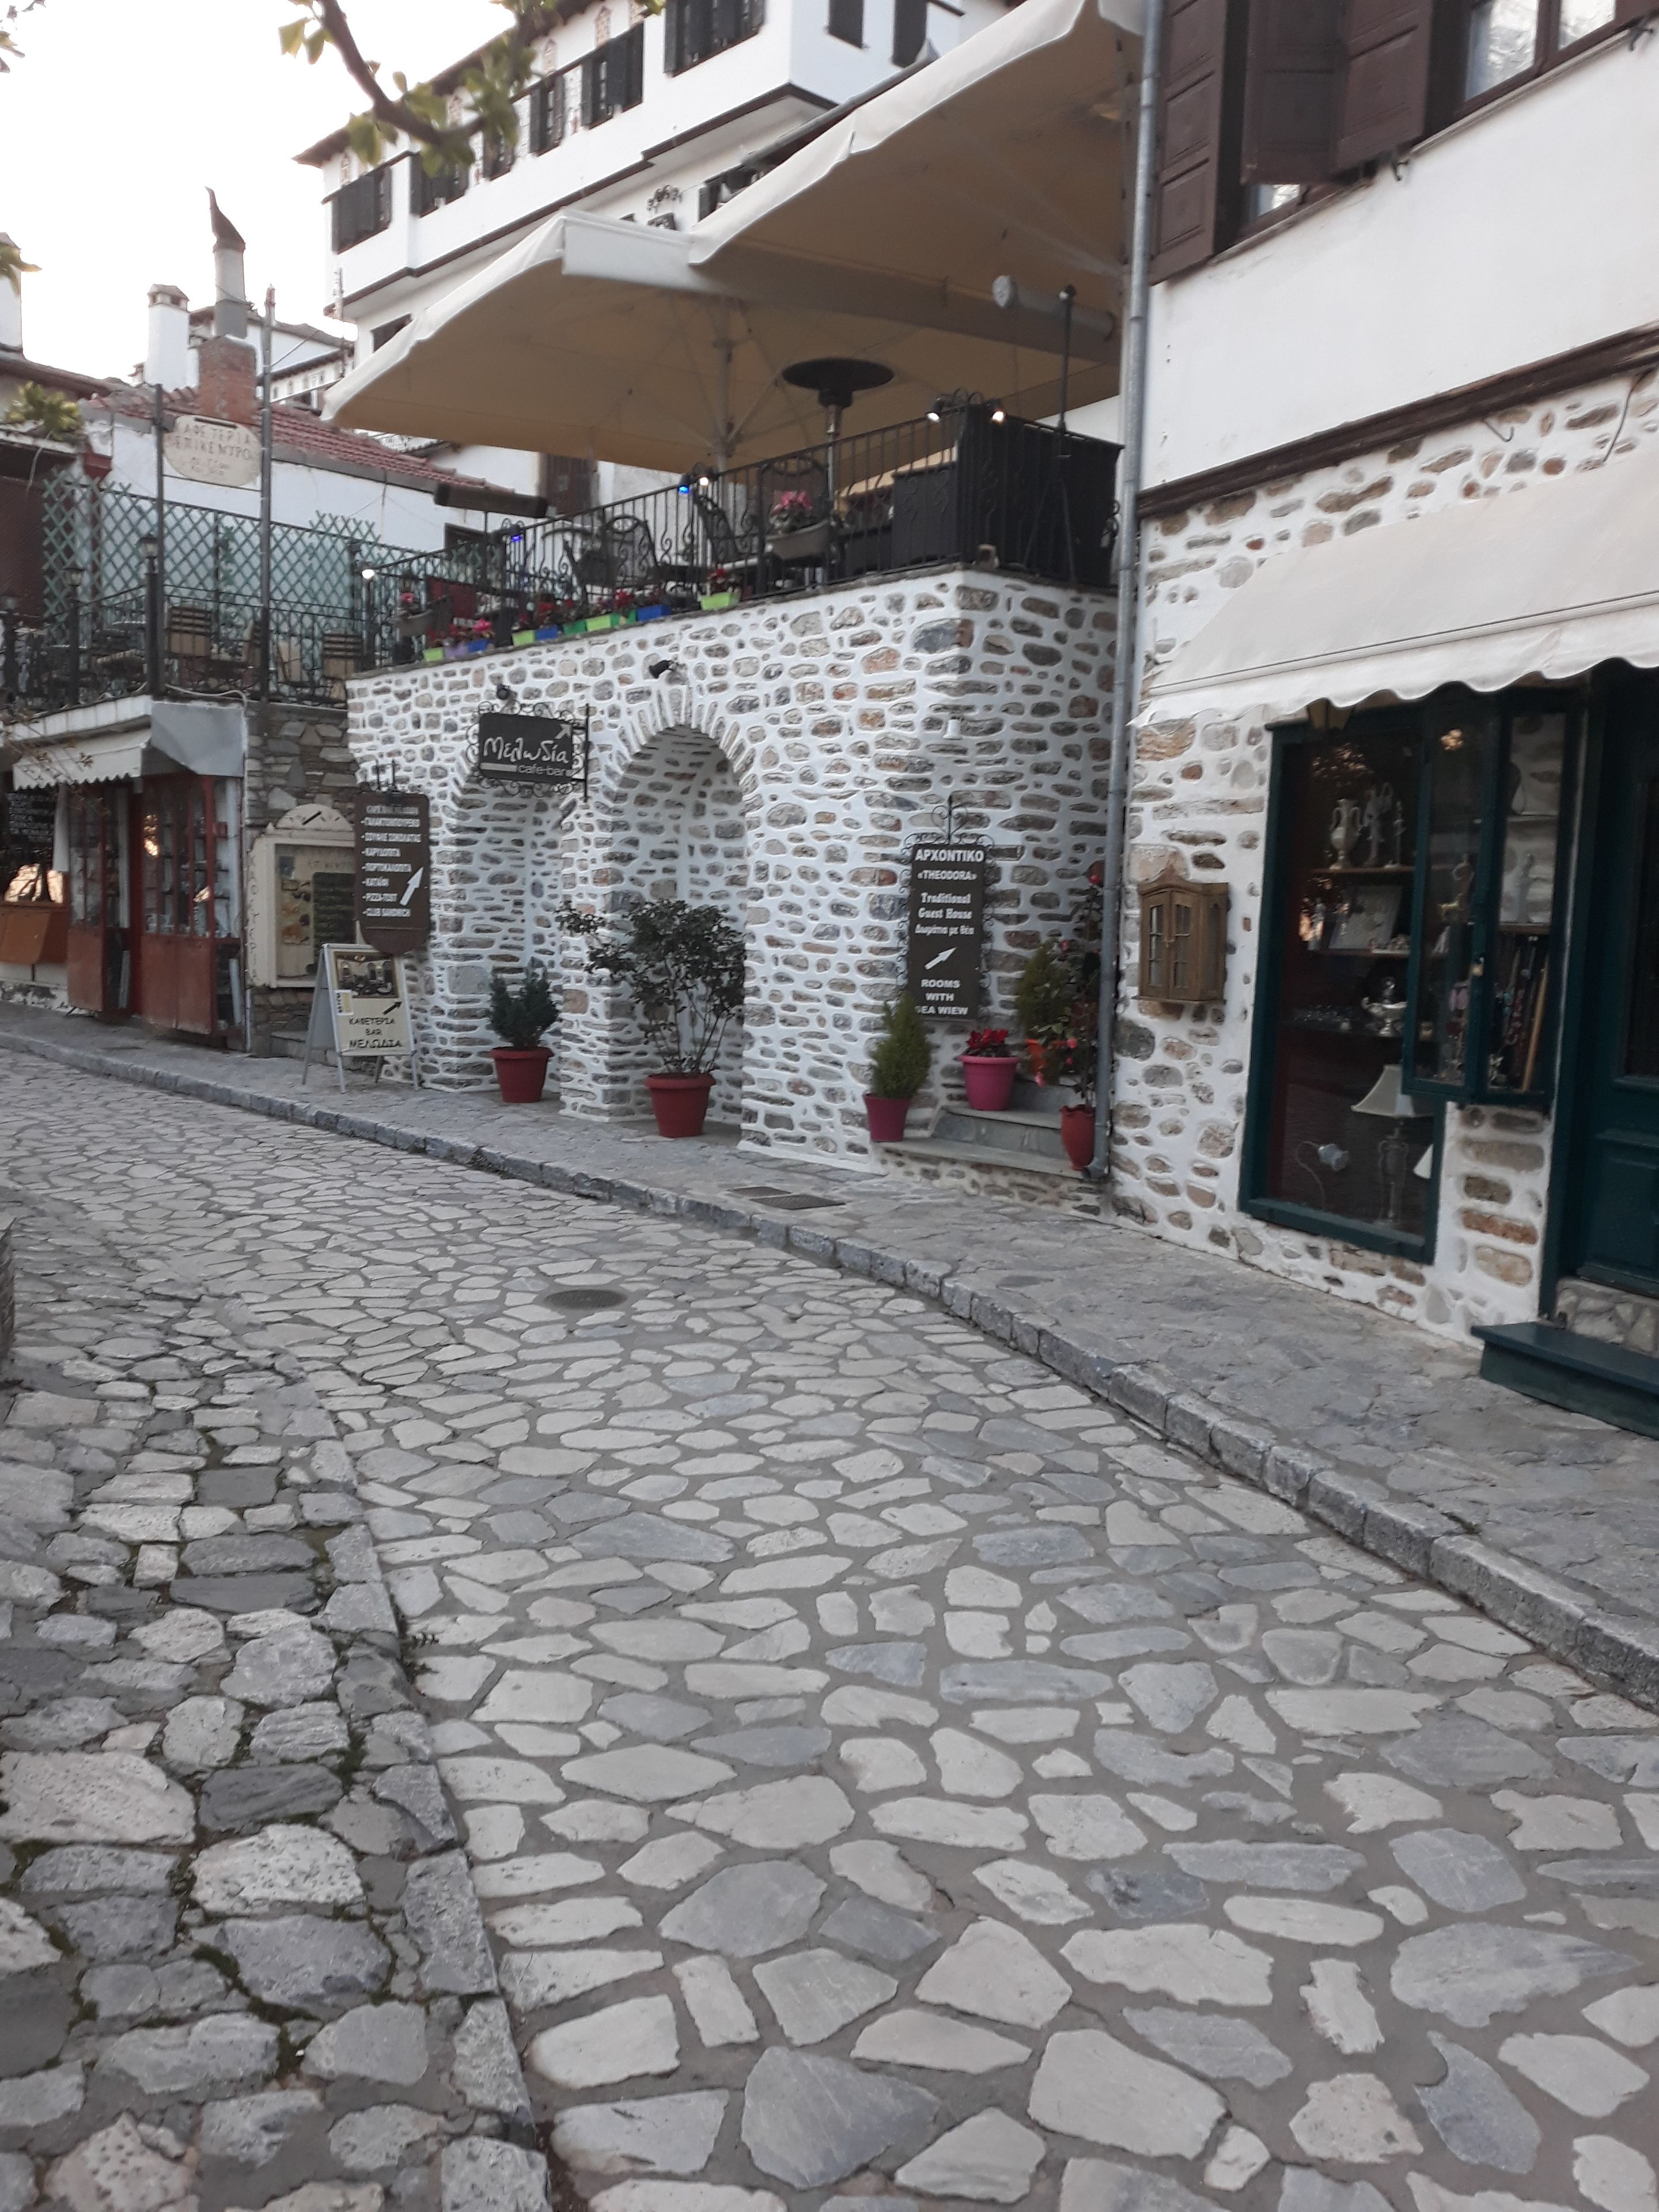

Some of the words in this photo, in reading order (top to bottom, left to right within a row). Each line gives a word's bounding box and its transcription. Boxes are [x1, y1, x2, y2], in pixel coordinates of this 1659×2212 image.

[915, 849, 984, 862] ΑΡΧΟΝΤΙΚΟ
[921, 892, 971, 904] Traditional
[918, 907, 943, 918] Guest
[945, 908, 972, 919] House
[921, 979, 960, 988] ROOMS
[925, 993, 955, 1001] WITH
[915, 1005, 936, 1014] SEA
[937, 1006, 969, 1015] WIEW
